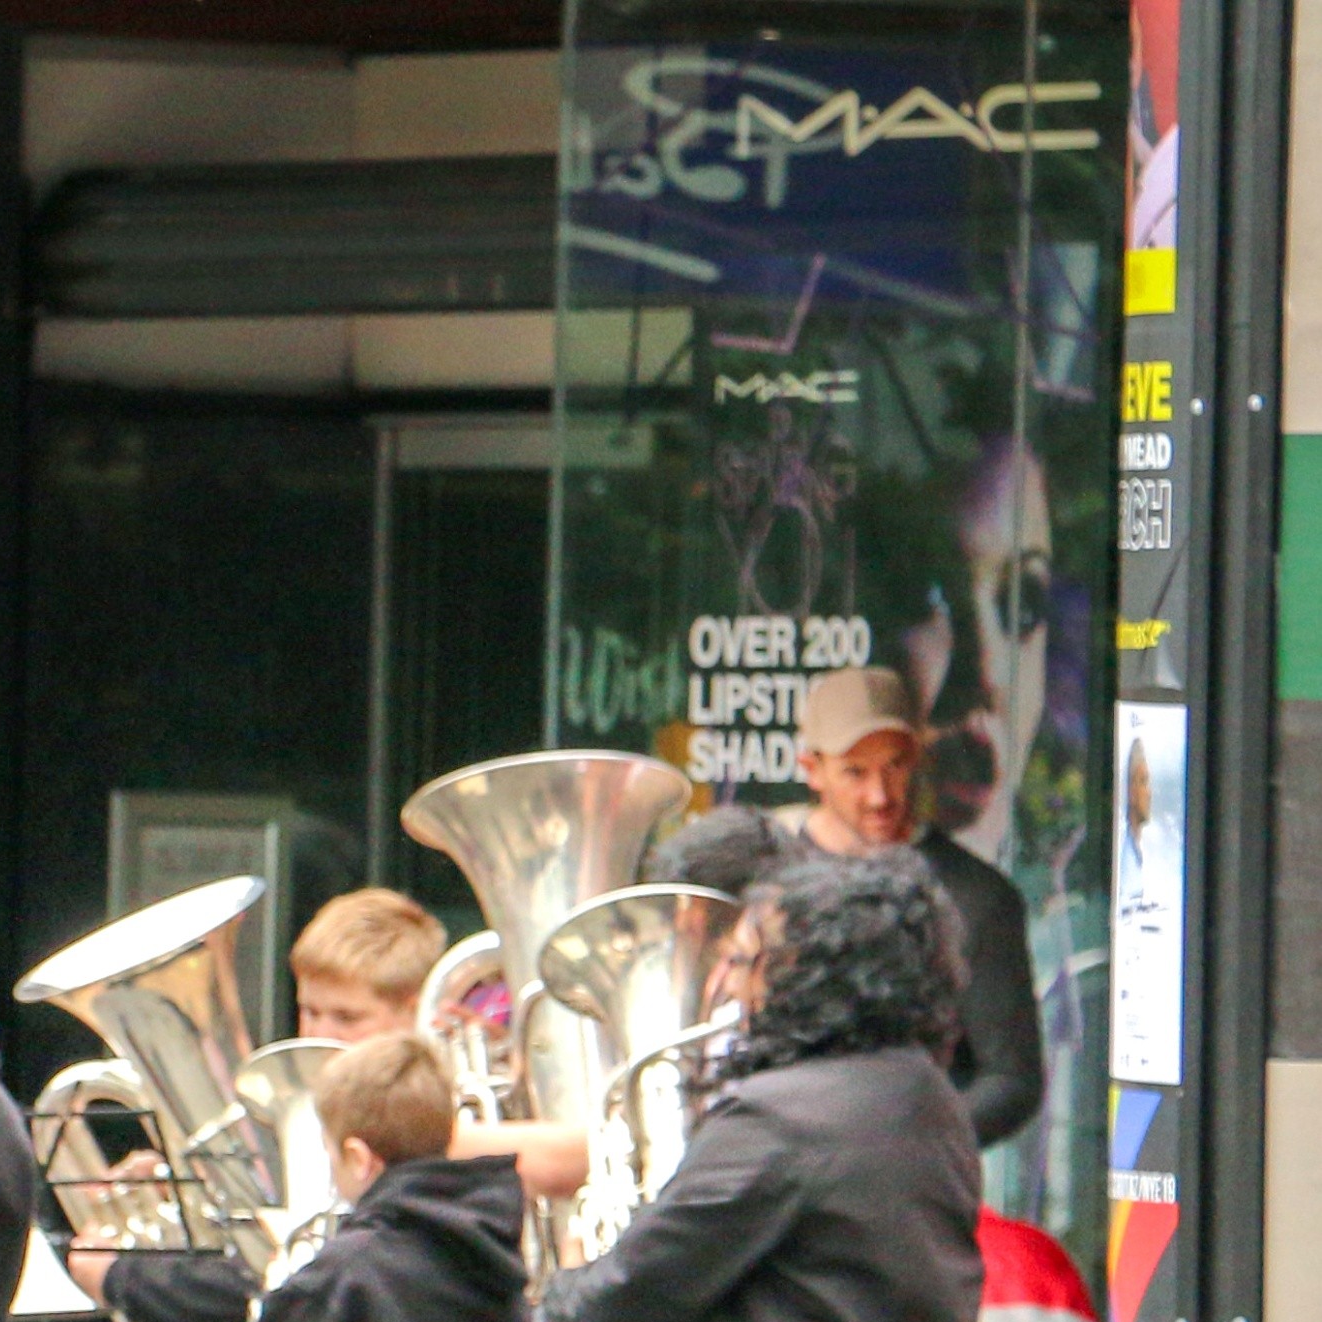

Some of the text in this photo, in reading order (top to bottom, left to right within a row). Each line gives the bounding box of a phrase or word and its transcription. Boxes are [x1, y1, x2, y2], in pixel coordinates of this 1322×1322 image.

[688, 614, 872, 669] OVER 200
[687, 672, 813, 727] LIPSTI
